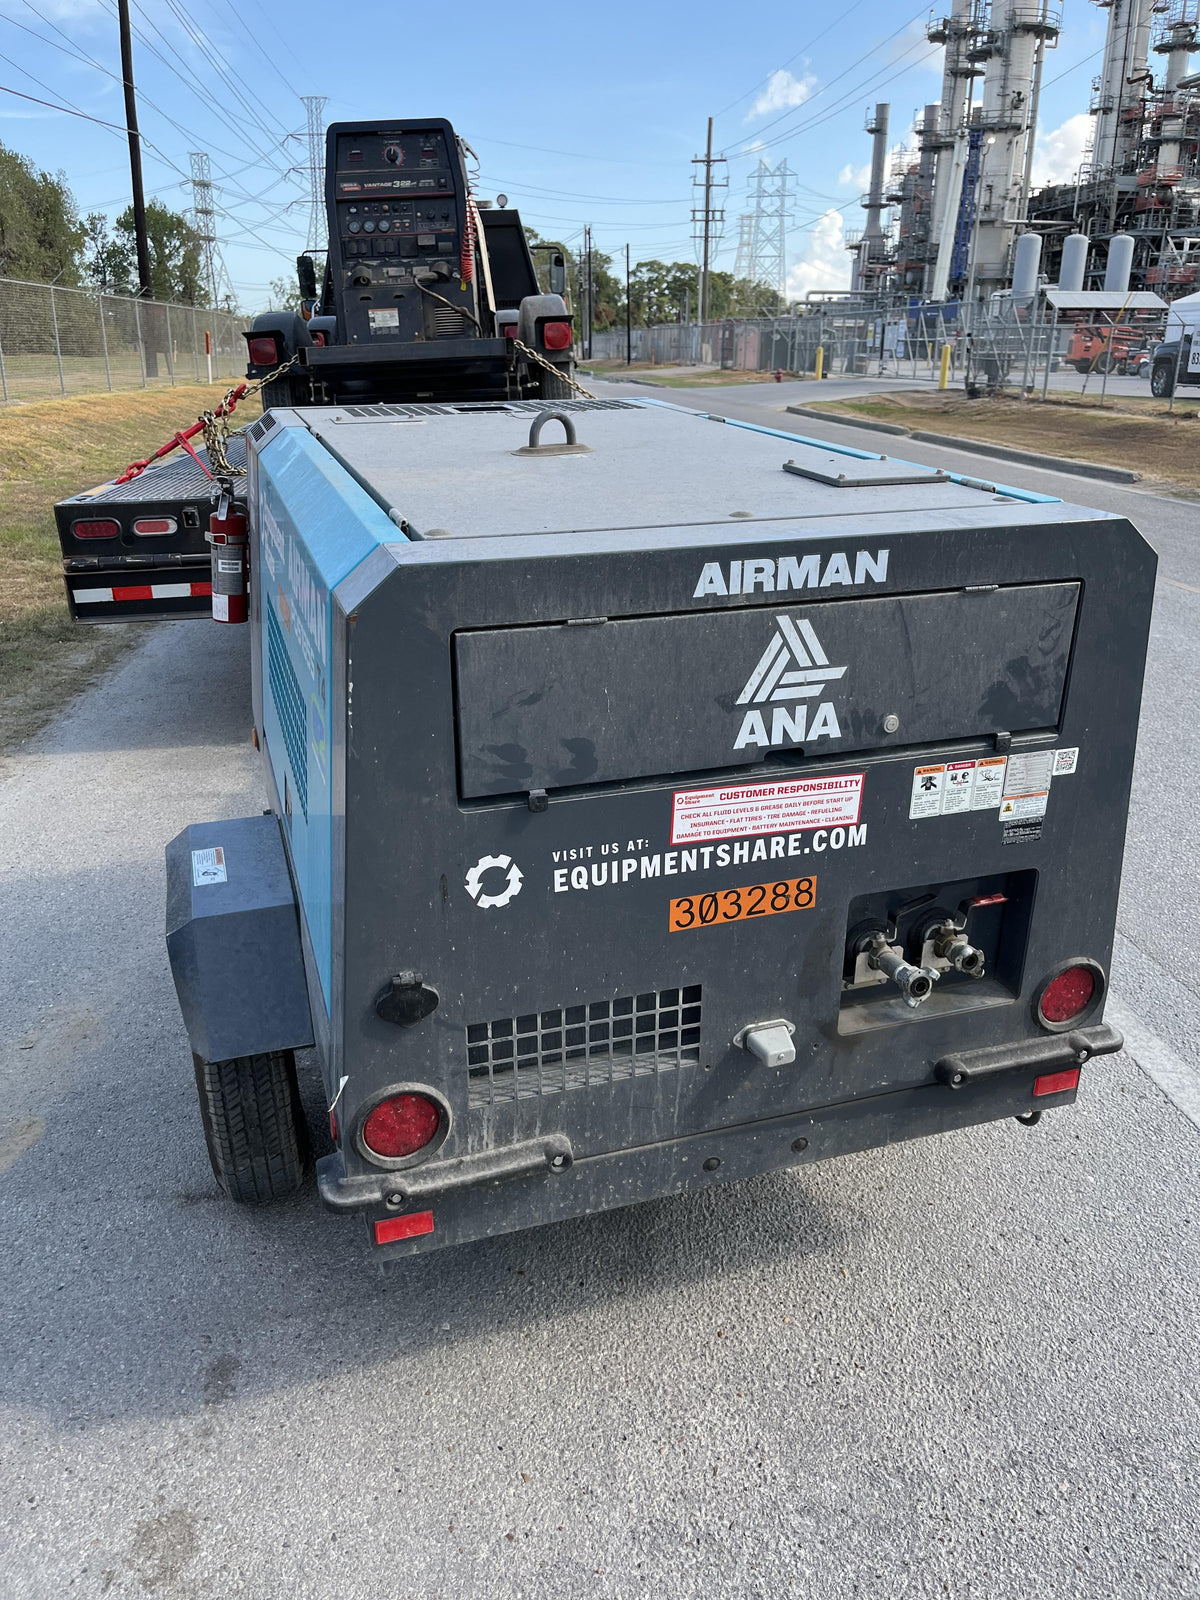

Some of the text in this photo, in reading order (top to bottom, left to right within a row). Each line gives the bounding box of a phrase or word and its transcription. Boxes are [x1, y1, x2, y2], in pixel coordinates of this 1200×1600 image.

[693, 549, 890, 598] AIRMAN
[289, 534, 326, 667] AIRMAN
[733, 702, 842, 750] ANA
[719, 779, 860, 800] CUSTOMER RESPONSIBILITY
[676, 831, 702, 839] DAMAGE
[712, 826, 747, 834] EQUIPMENT
[778, 818, 820, 827] MAINTENANCE
[824, 814, 853, 822] CLEANING
[690, 819, 724, 828] INSURANCE
[781, 810, 806, 818] DAMAGE
[810, 807, 842, 815] REFUELING
[732, 806, 753, 814] LEVELS
[760, 803, 782, 811] GREASE
[552, 838, 649, 863] VISIT US AT:
[553, 823, 868, 893] EQUIPMENTSHARE.COM
[674, 877, 814, 928] 303288
